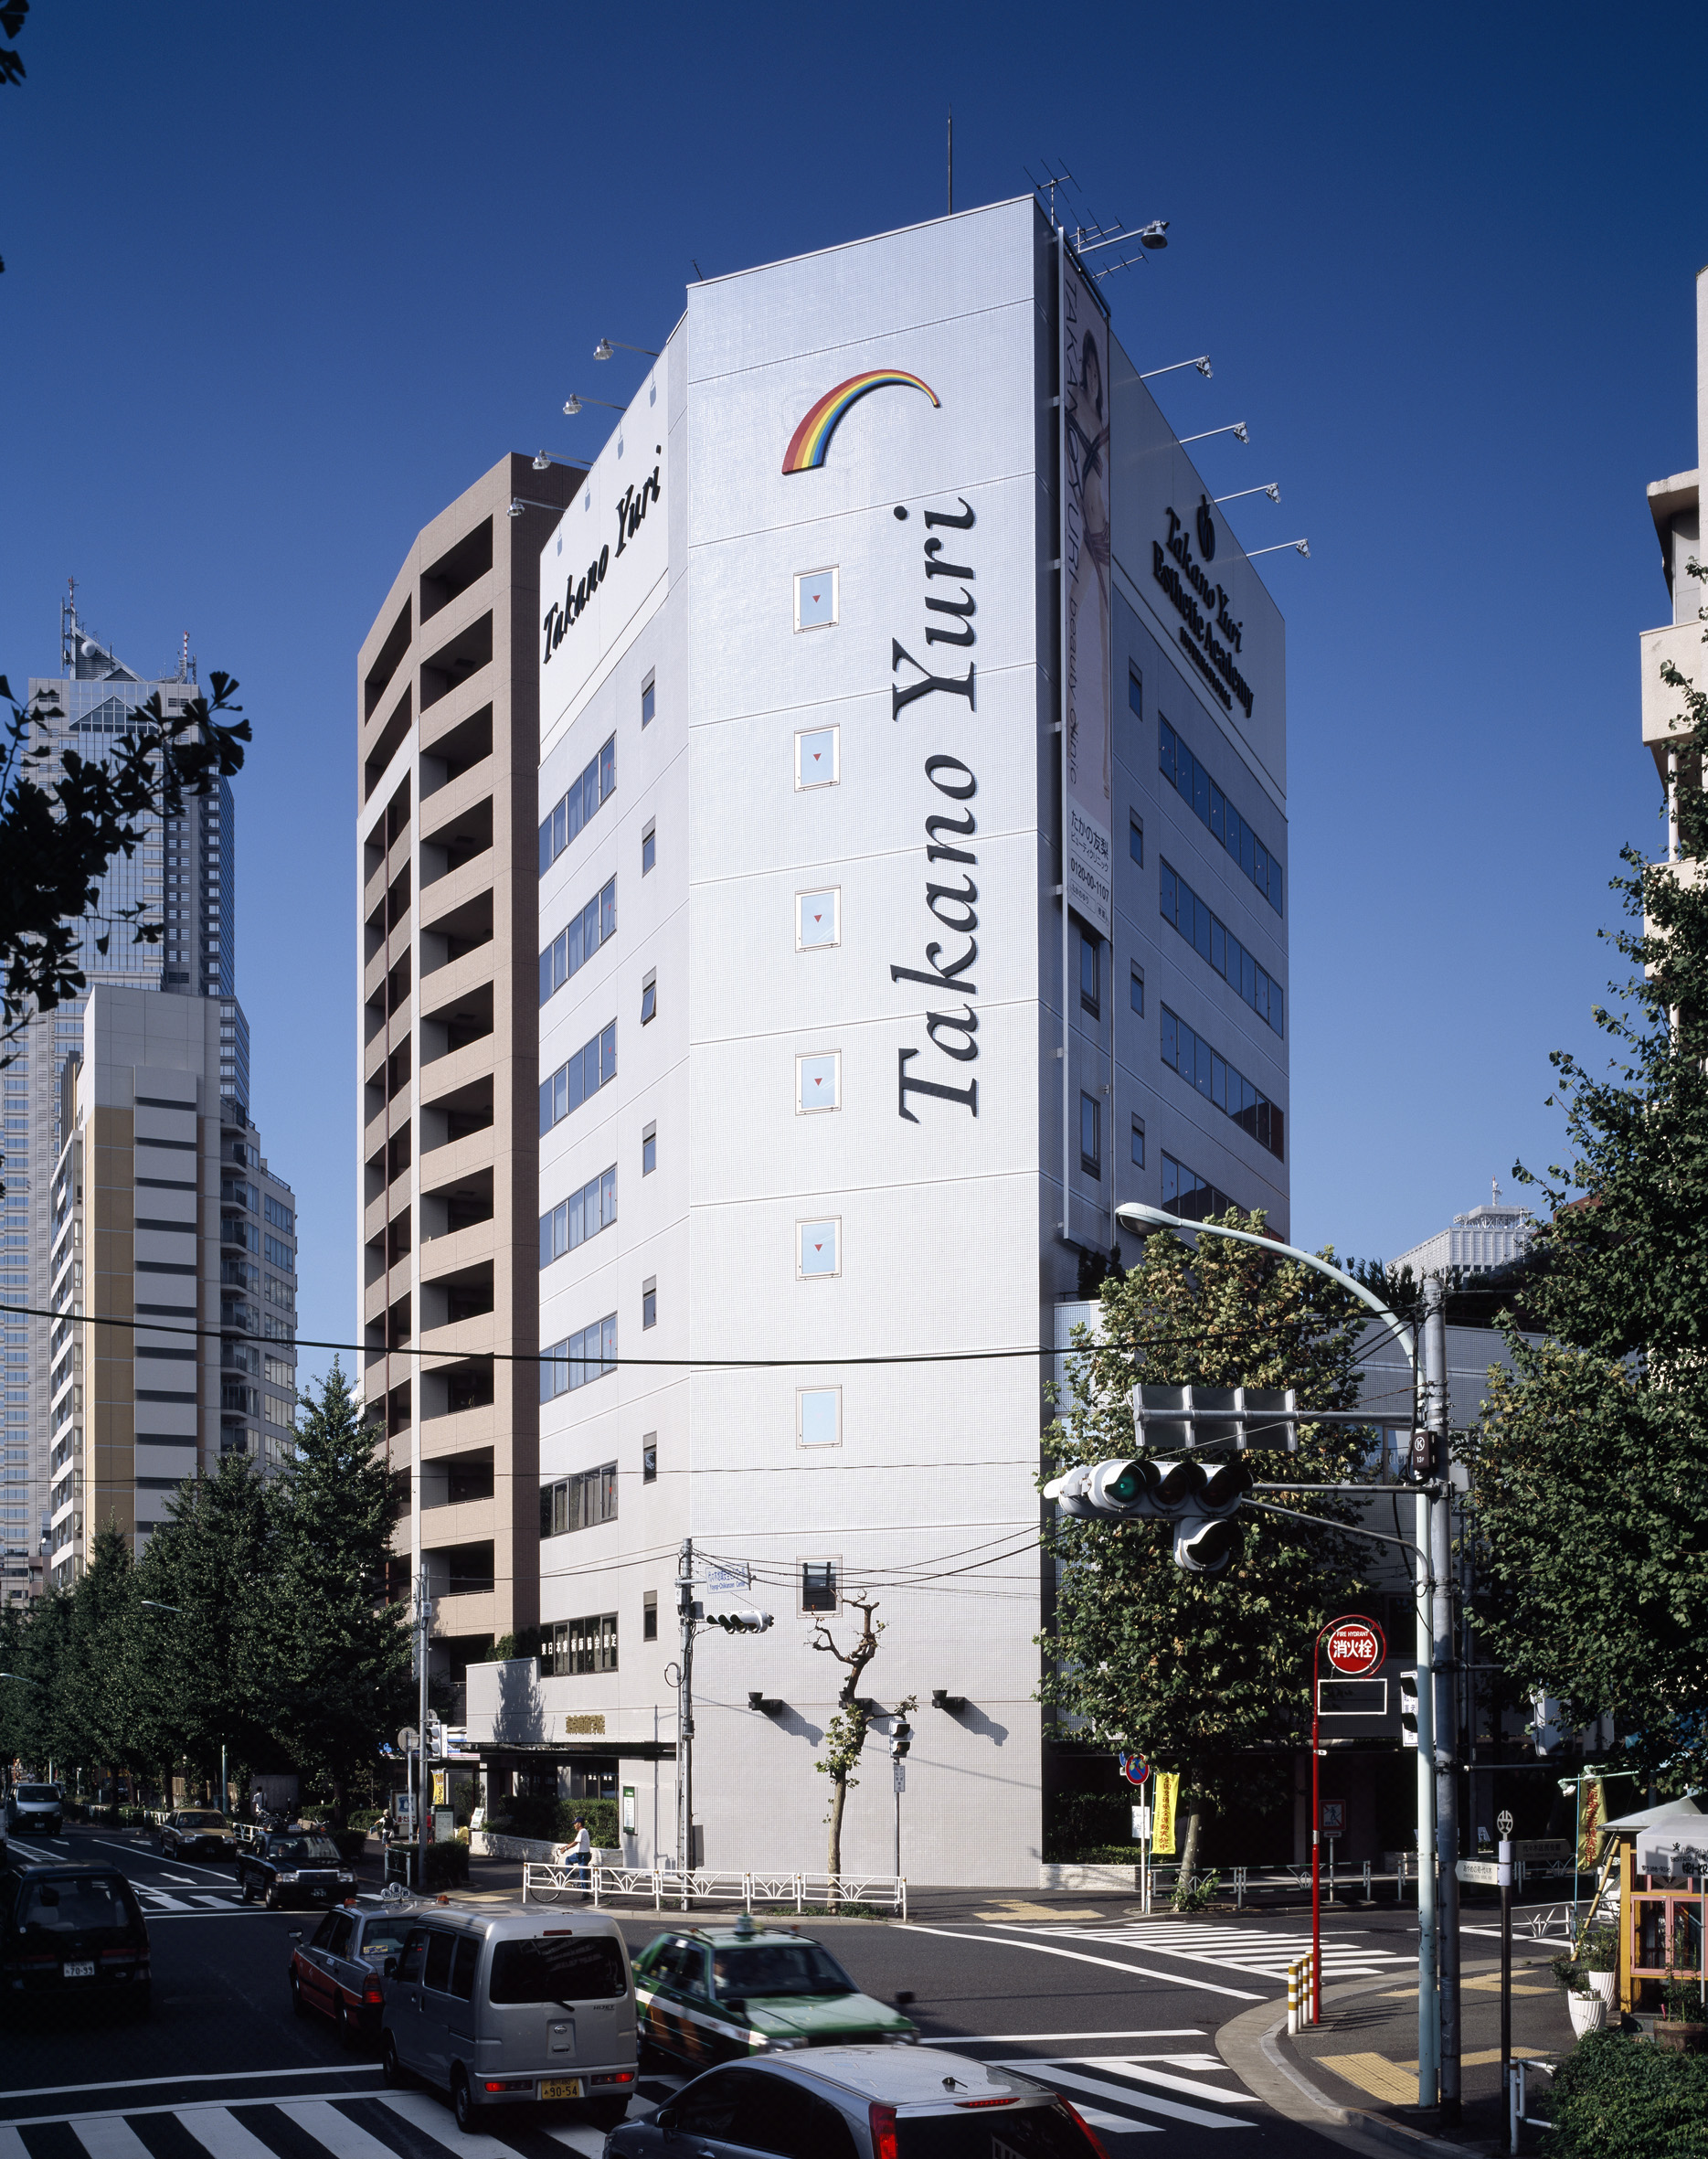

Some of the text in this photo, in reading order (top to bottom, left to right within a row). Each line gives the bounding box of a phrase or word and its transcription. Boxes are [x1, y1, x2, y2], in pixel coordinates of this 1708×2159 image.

[543, 444, 662, 665] Takano Yuri
[1165, 506, 1243, 653] Takano Yuri
[1067, 597, 1079, 701] beauty
[1152, 539, 1254, 718] Esthetic Academy
[1068, 707, 1079, 785] clinic
[890, 496, 978, 1124] Takano Yuri
[1071, 809, 1109, 860] たかの友梨
[1071, 857, 1109, 902] 0120-00-1107
[1332, 1639, 1374, 1658] 消火栓
[1159, 1776, 1172, 1850] 全国交通安全運動実施中
[69, 1966, 93, 1975] 70-99
[550, 2085, 578, 2098] 90-54
